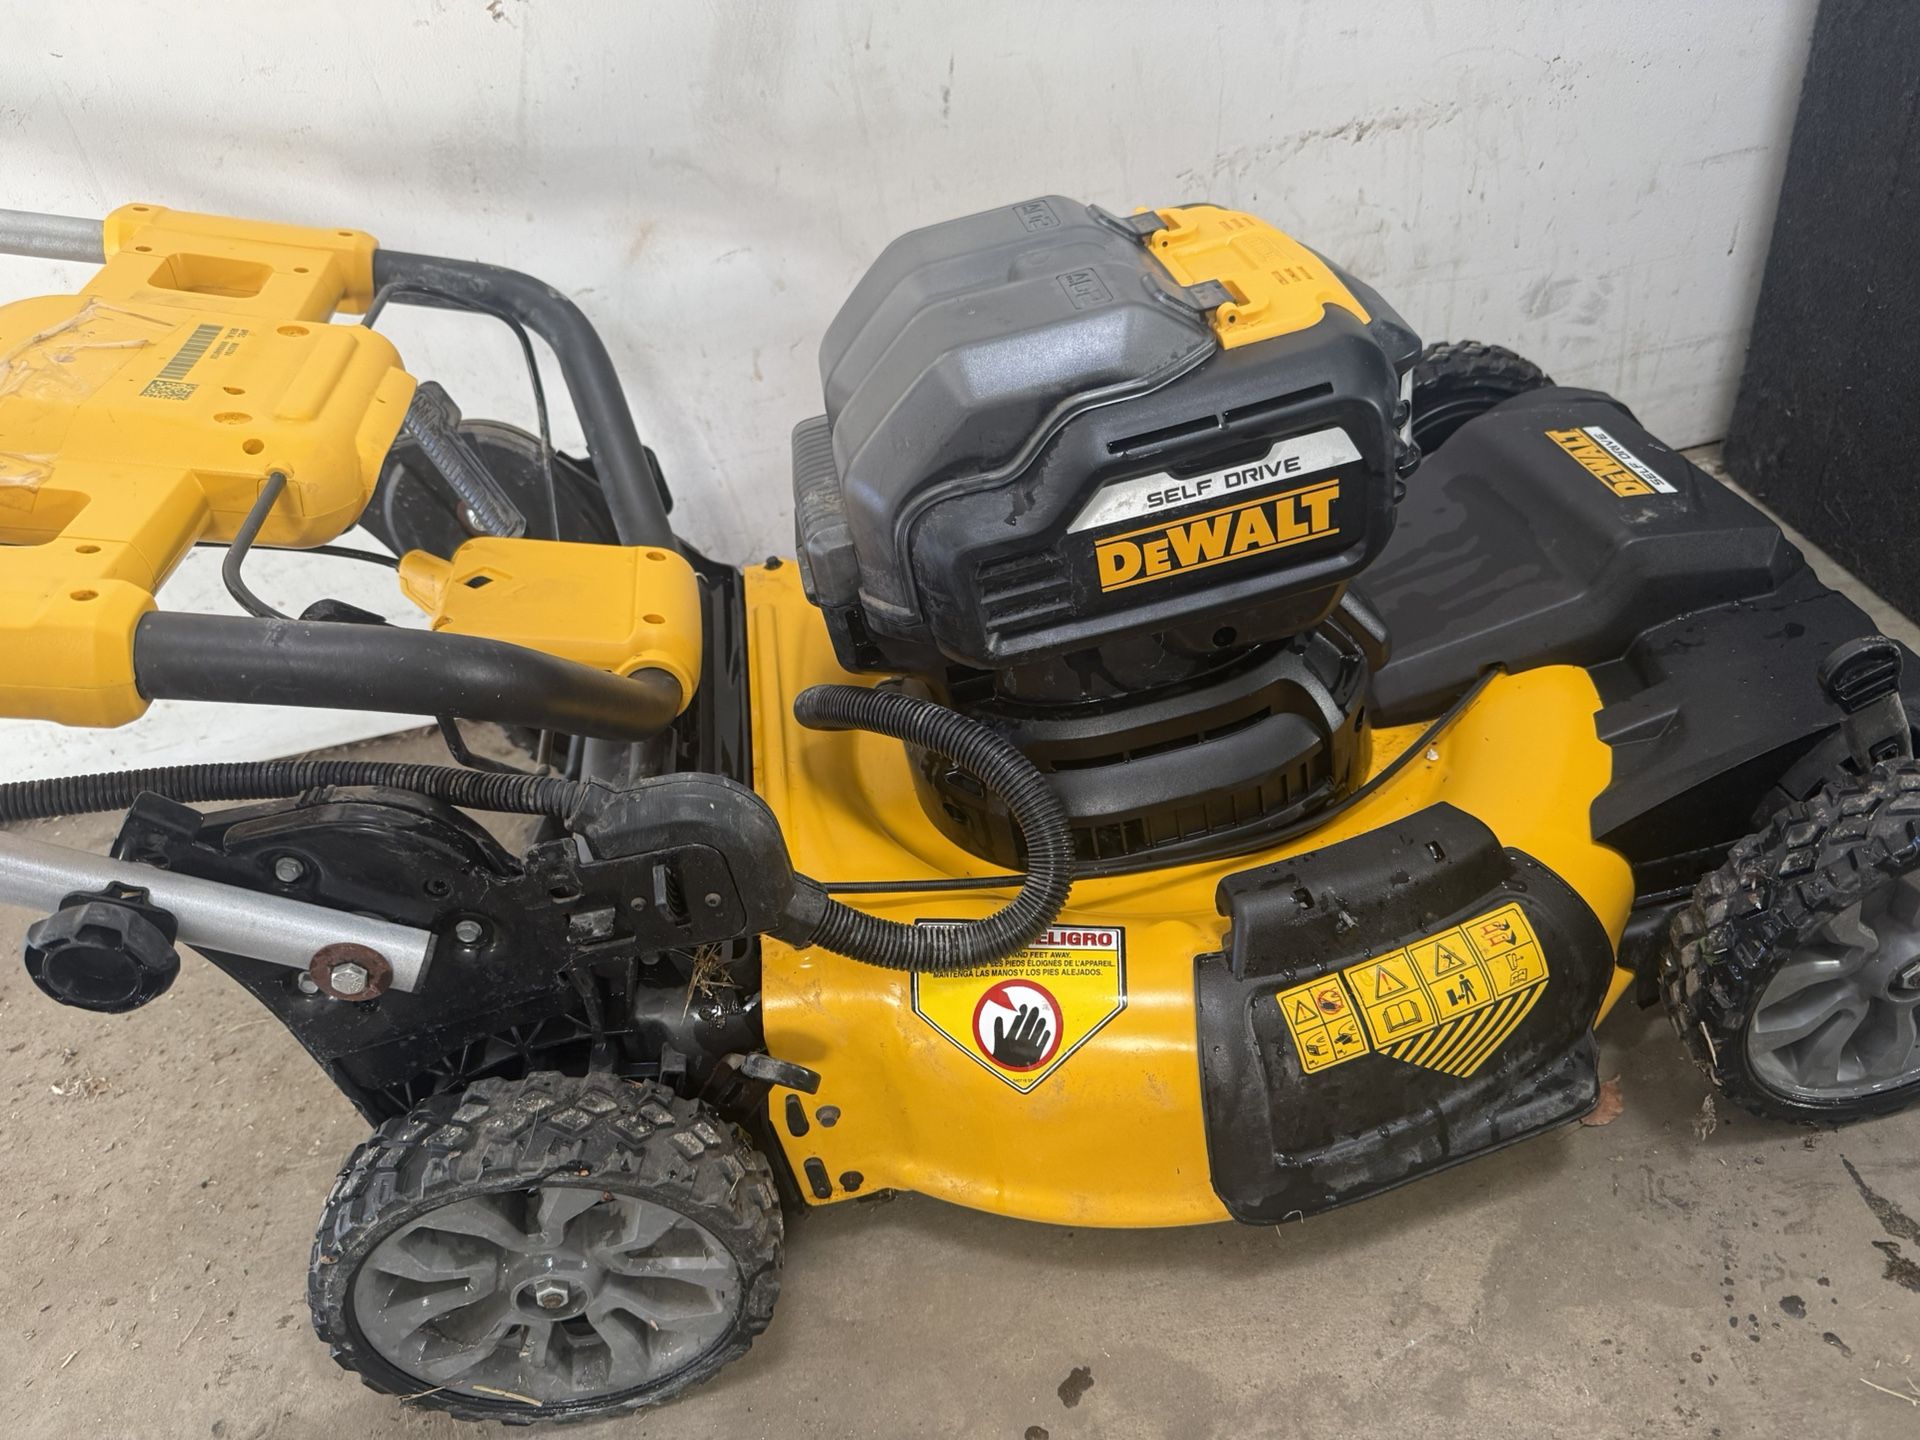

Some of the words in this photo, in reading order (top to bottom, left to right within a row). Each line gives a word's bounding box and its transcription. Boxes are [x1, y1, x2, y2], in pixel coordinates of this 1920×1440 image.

[1594, 433, 1632, 460] DRIVE
[1545, 429, 1653, 496] DEWALT
[1629, 461, 1665, 486] SELF
[1146, 478, 1213, 509] SELF
[1224, 456, 1302, 489] DRIVE
[1095, 484, 1340, 588] DEWALT
[1035, 931, 1113, 946] ELIGRO
[975, 969, 990, 977] LAS
[991, 968, 1018, 977] MANOS
